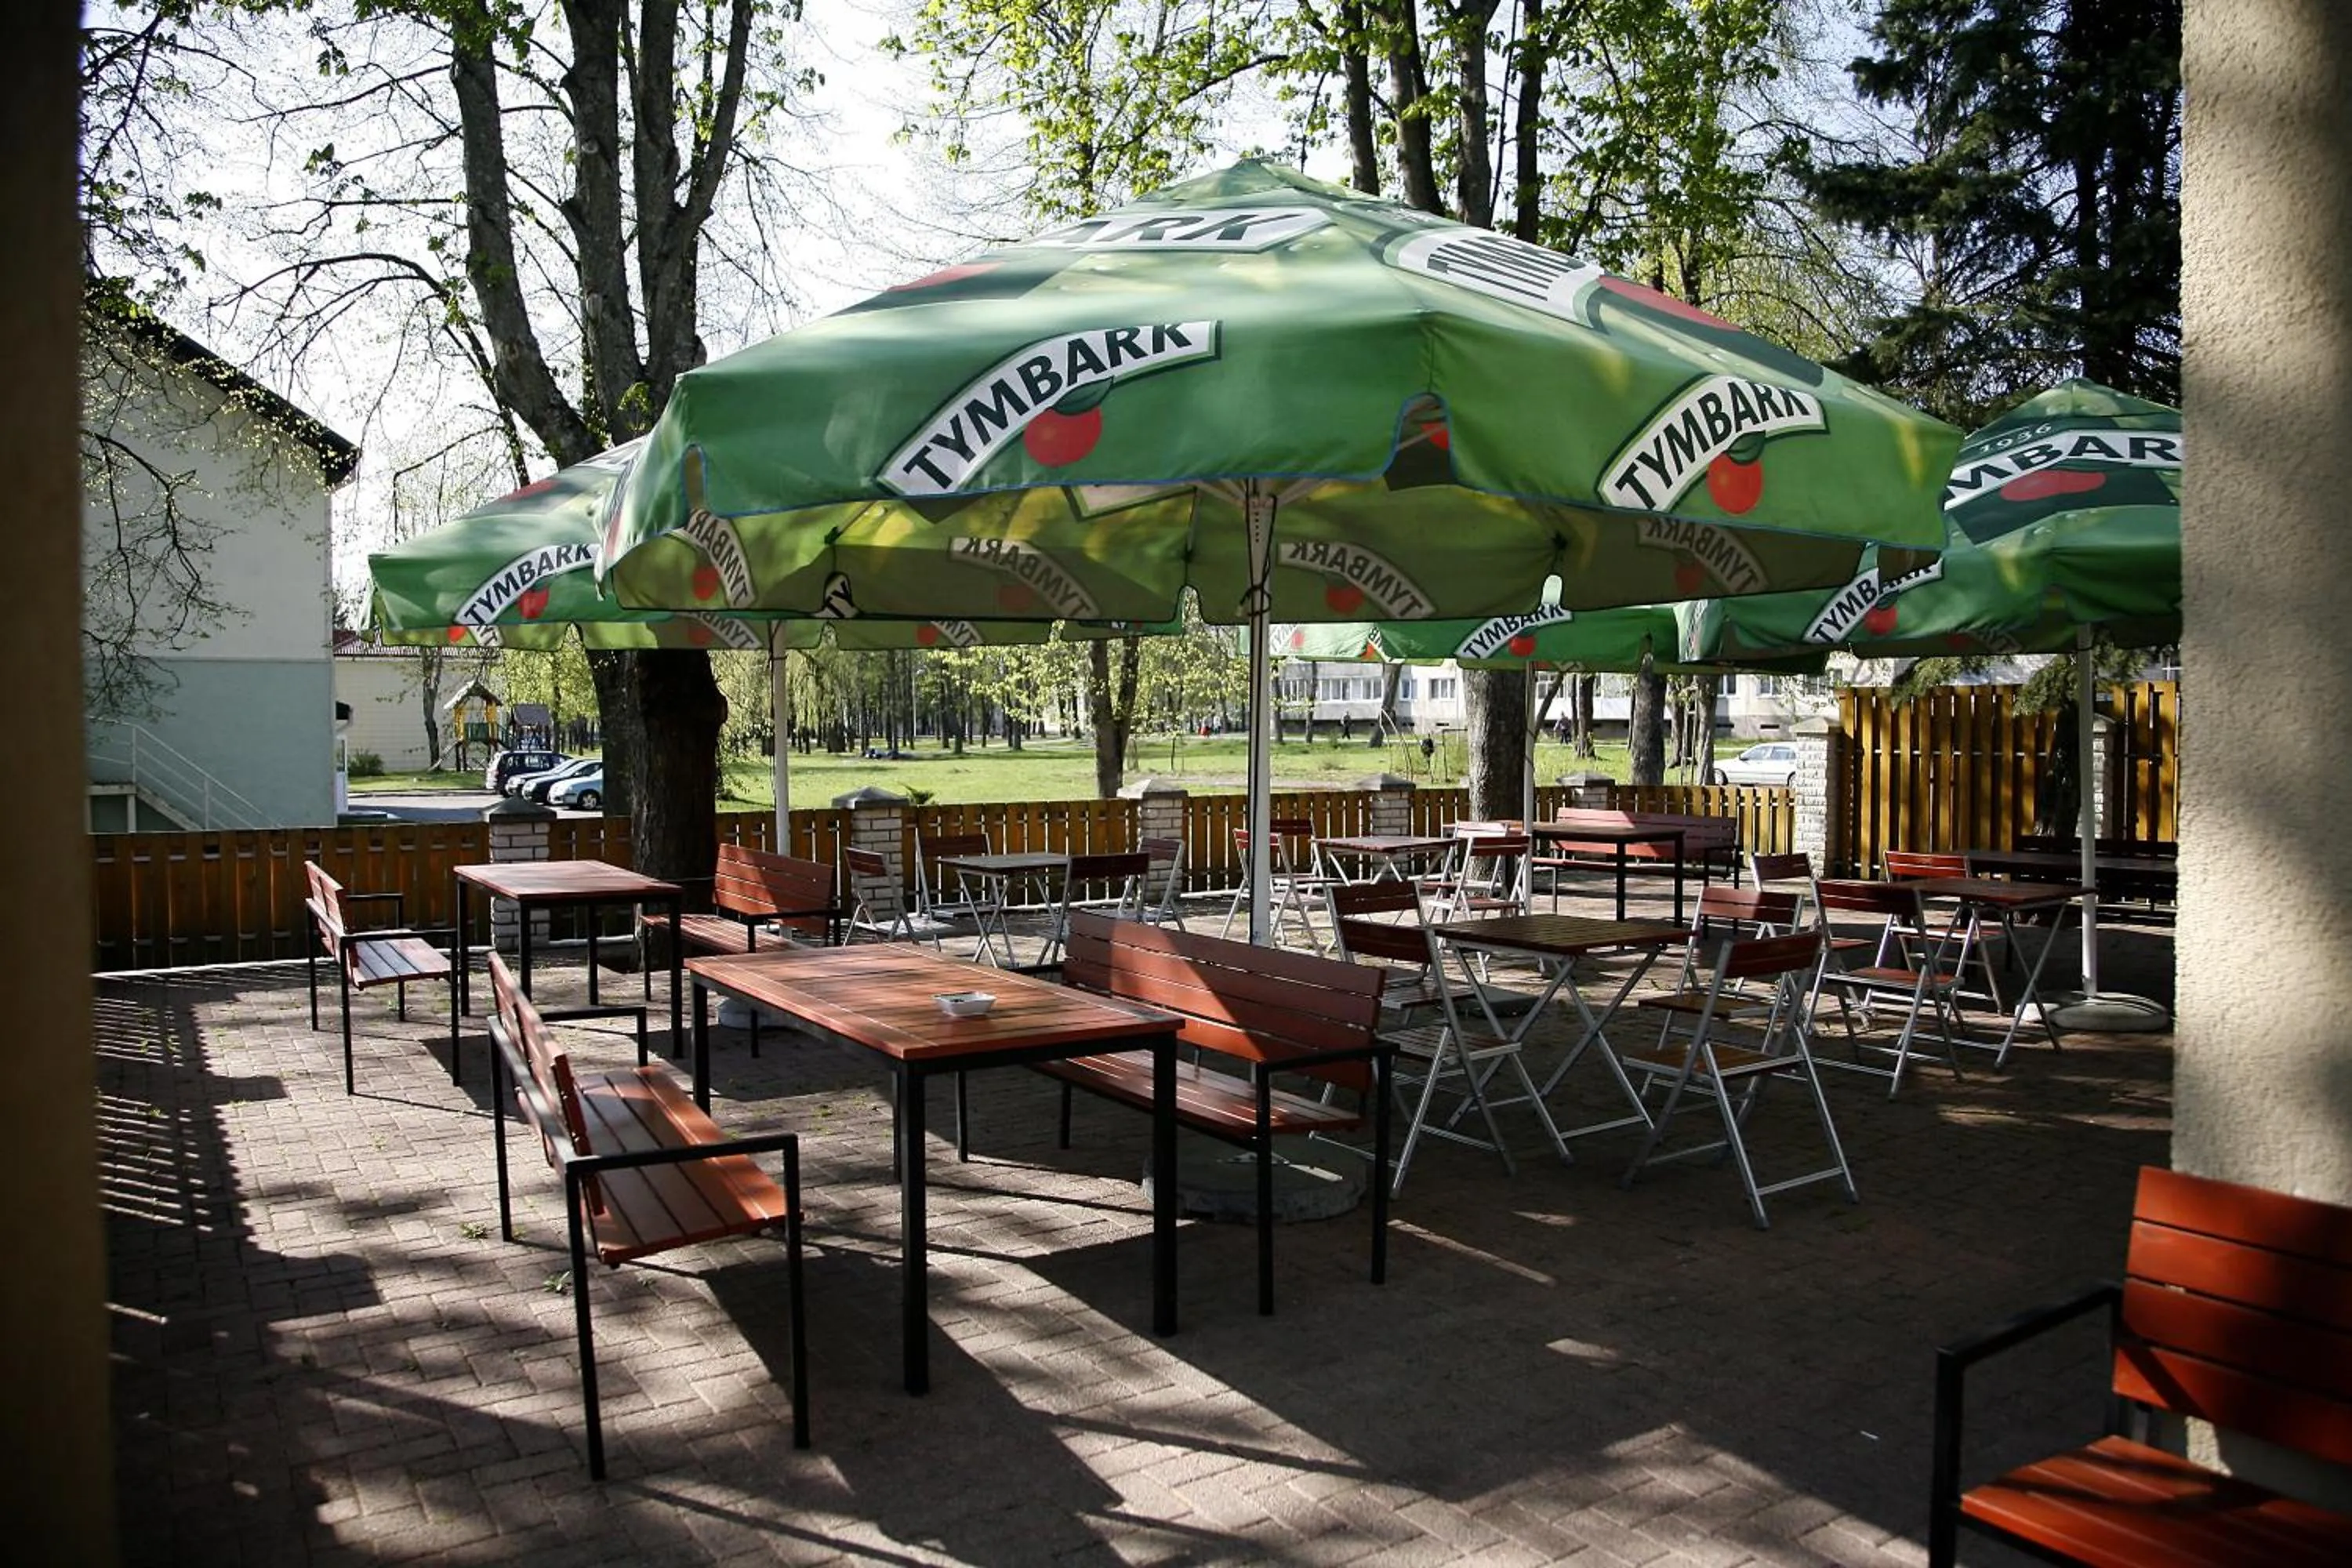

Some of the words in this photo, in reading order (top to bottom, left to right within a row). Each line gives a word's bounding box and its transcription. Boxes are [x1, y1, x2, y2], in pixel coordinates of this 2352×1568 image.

[902, 323, 1192, 490] TYMBARK
[1615, 381, 1810, 510] TYMBARK
[1944, 435, 2182, 501] MBAR
[464, 543, 593, 626] TYMBARK
